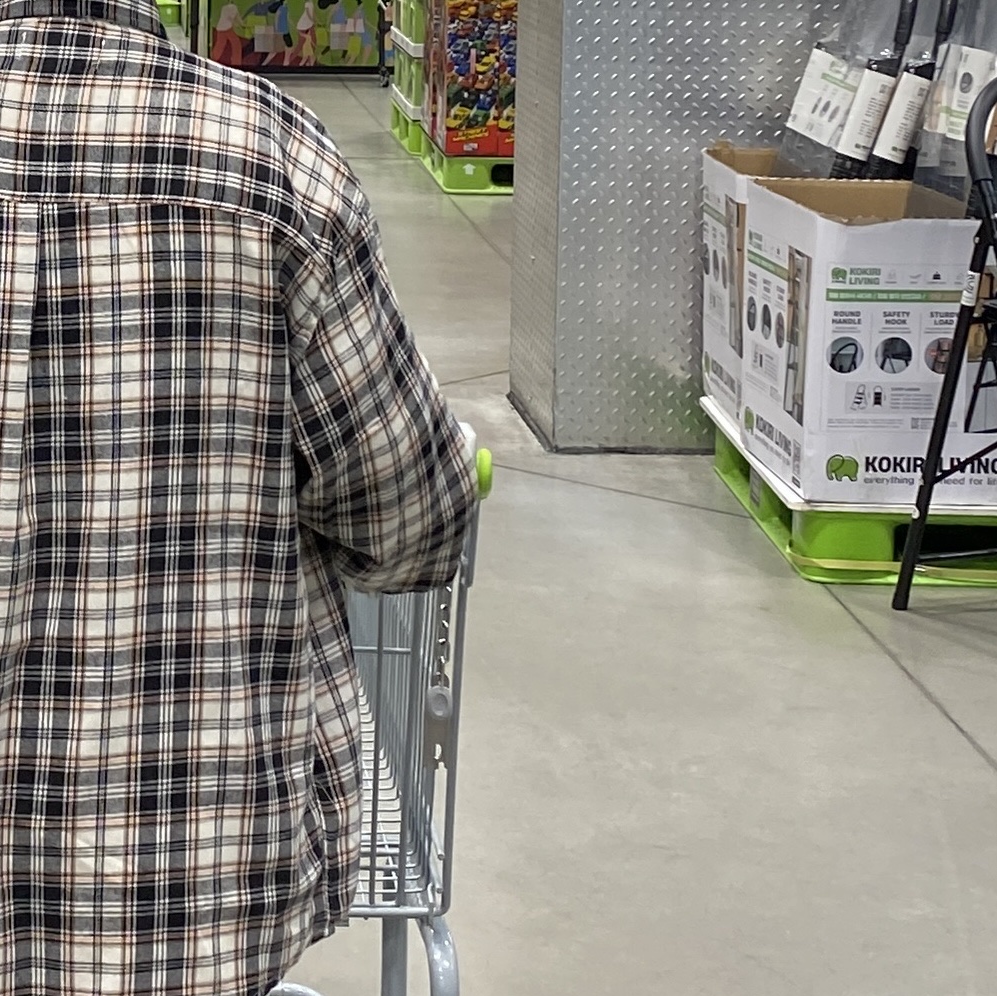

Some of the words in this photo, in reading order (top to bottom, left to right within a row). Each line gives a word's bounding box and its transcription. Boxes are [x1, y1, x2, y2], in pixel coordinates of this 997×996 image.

[849, 267, 881, 276] KOKIRI
[848, 277, 880, 285] LIVING
[865, 456, 926, 473] KOKIR
[863, 476, 915, 486] everything
[969, 477, 983, 486] for
